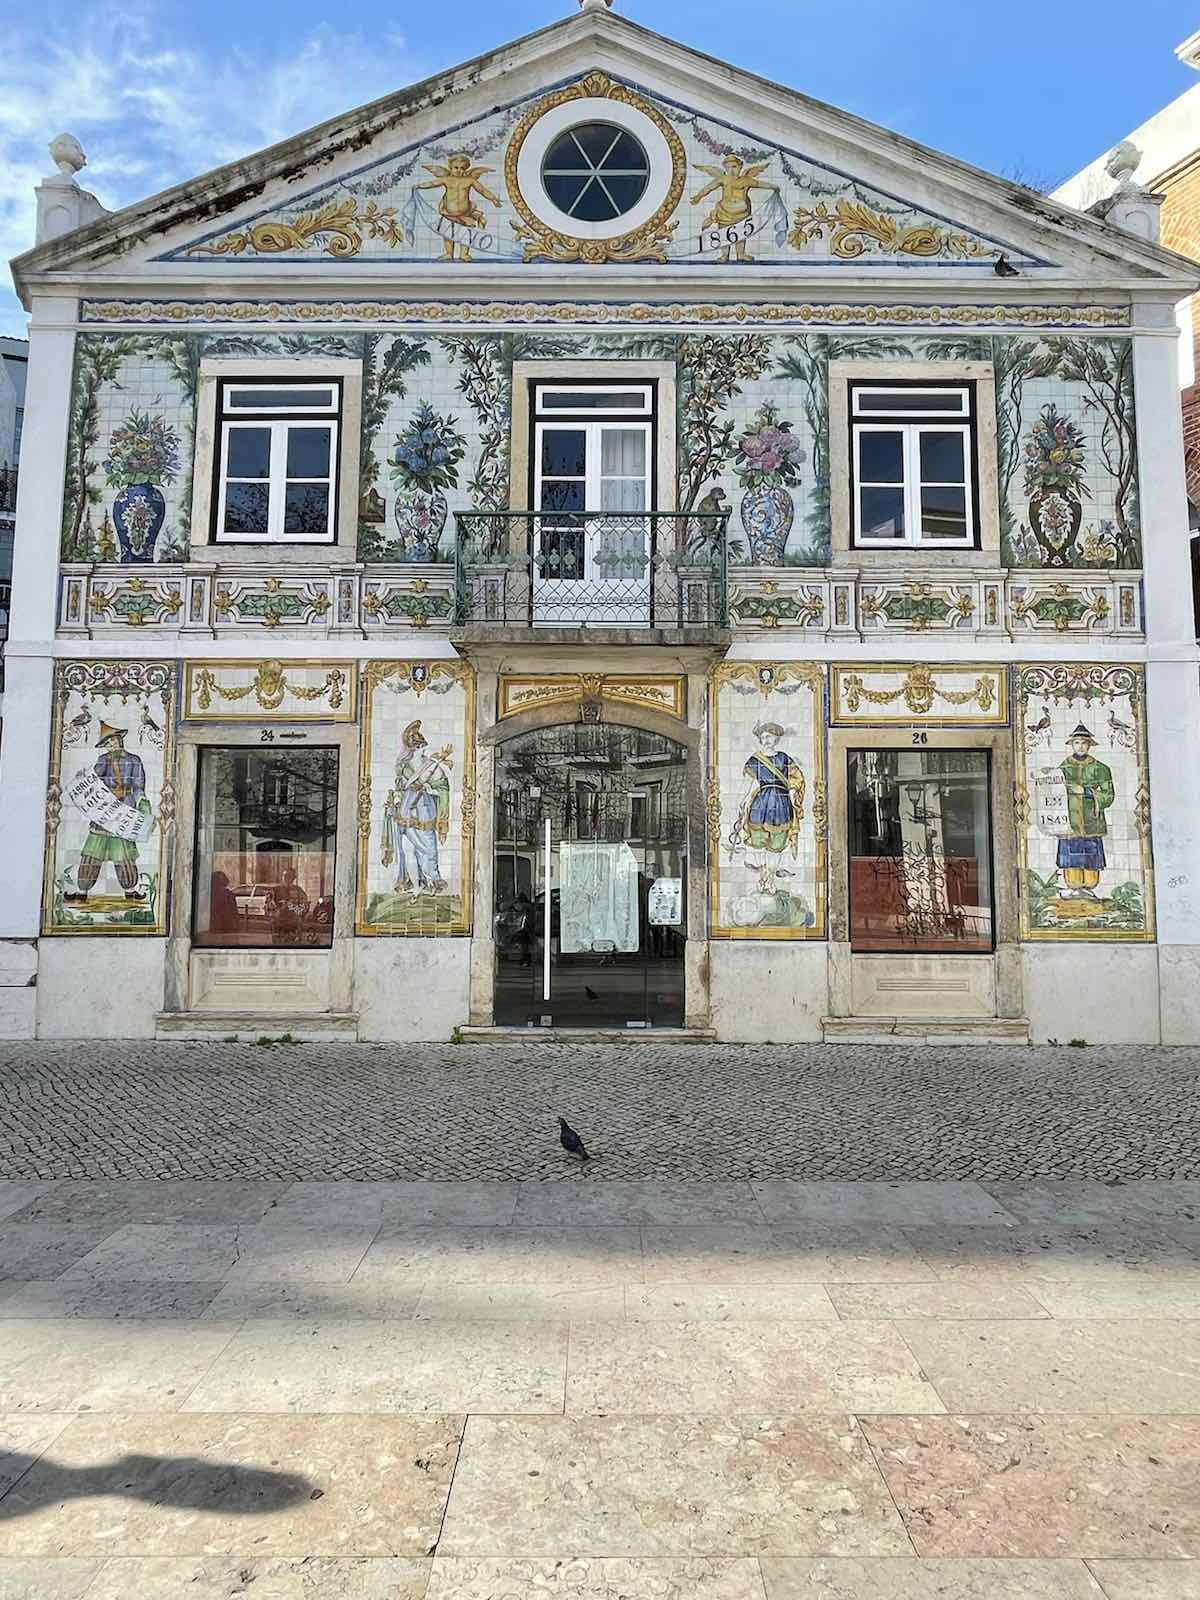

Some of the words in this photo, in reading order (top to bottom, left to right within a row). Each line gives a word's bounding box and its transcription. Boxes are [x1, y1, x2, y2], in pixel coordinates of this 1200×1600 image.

[698, 217, 754, 254] 1865
[261, 729, 274, 741] 24
[912, 732, 928, 744] 26
[1041, 815, 1068, 825] 1849
